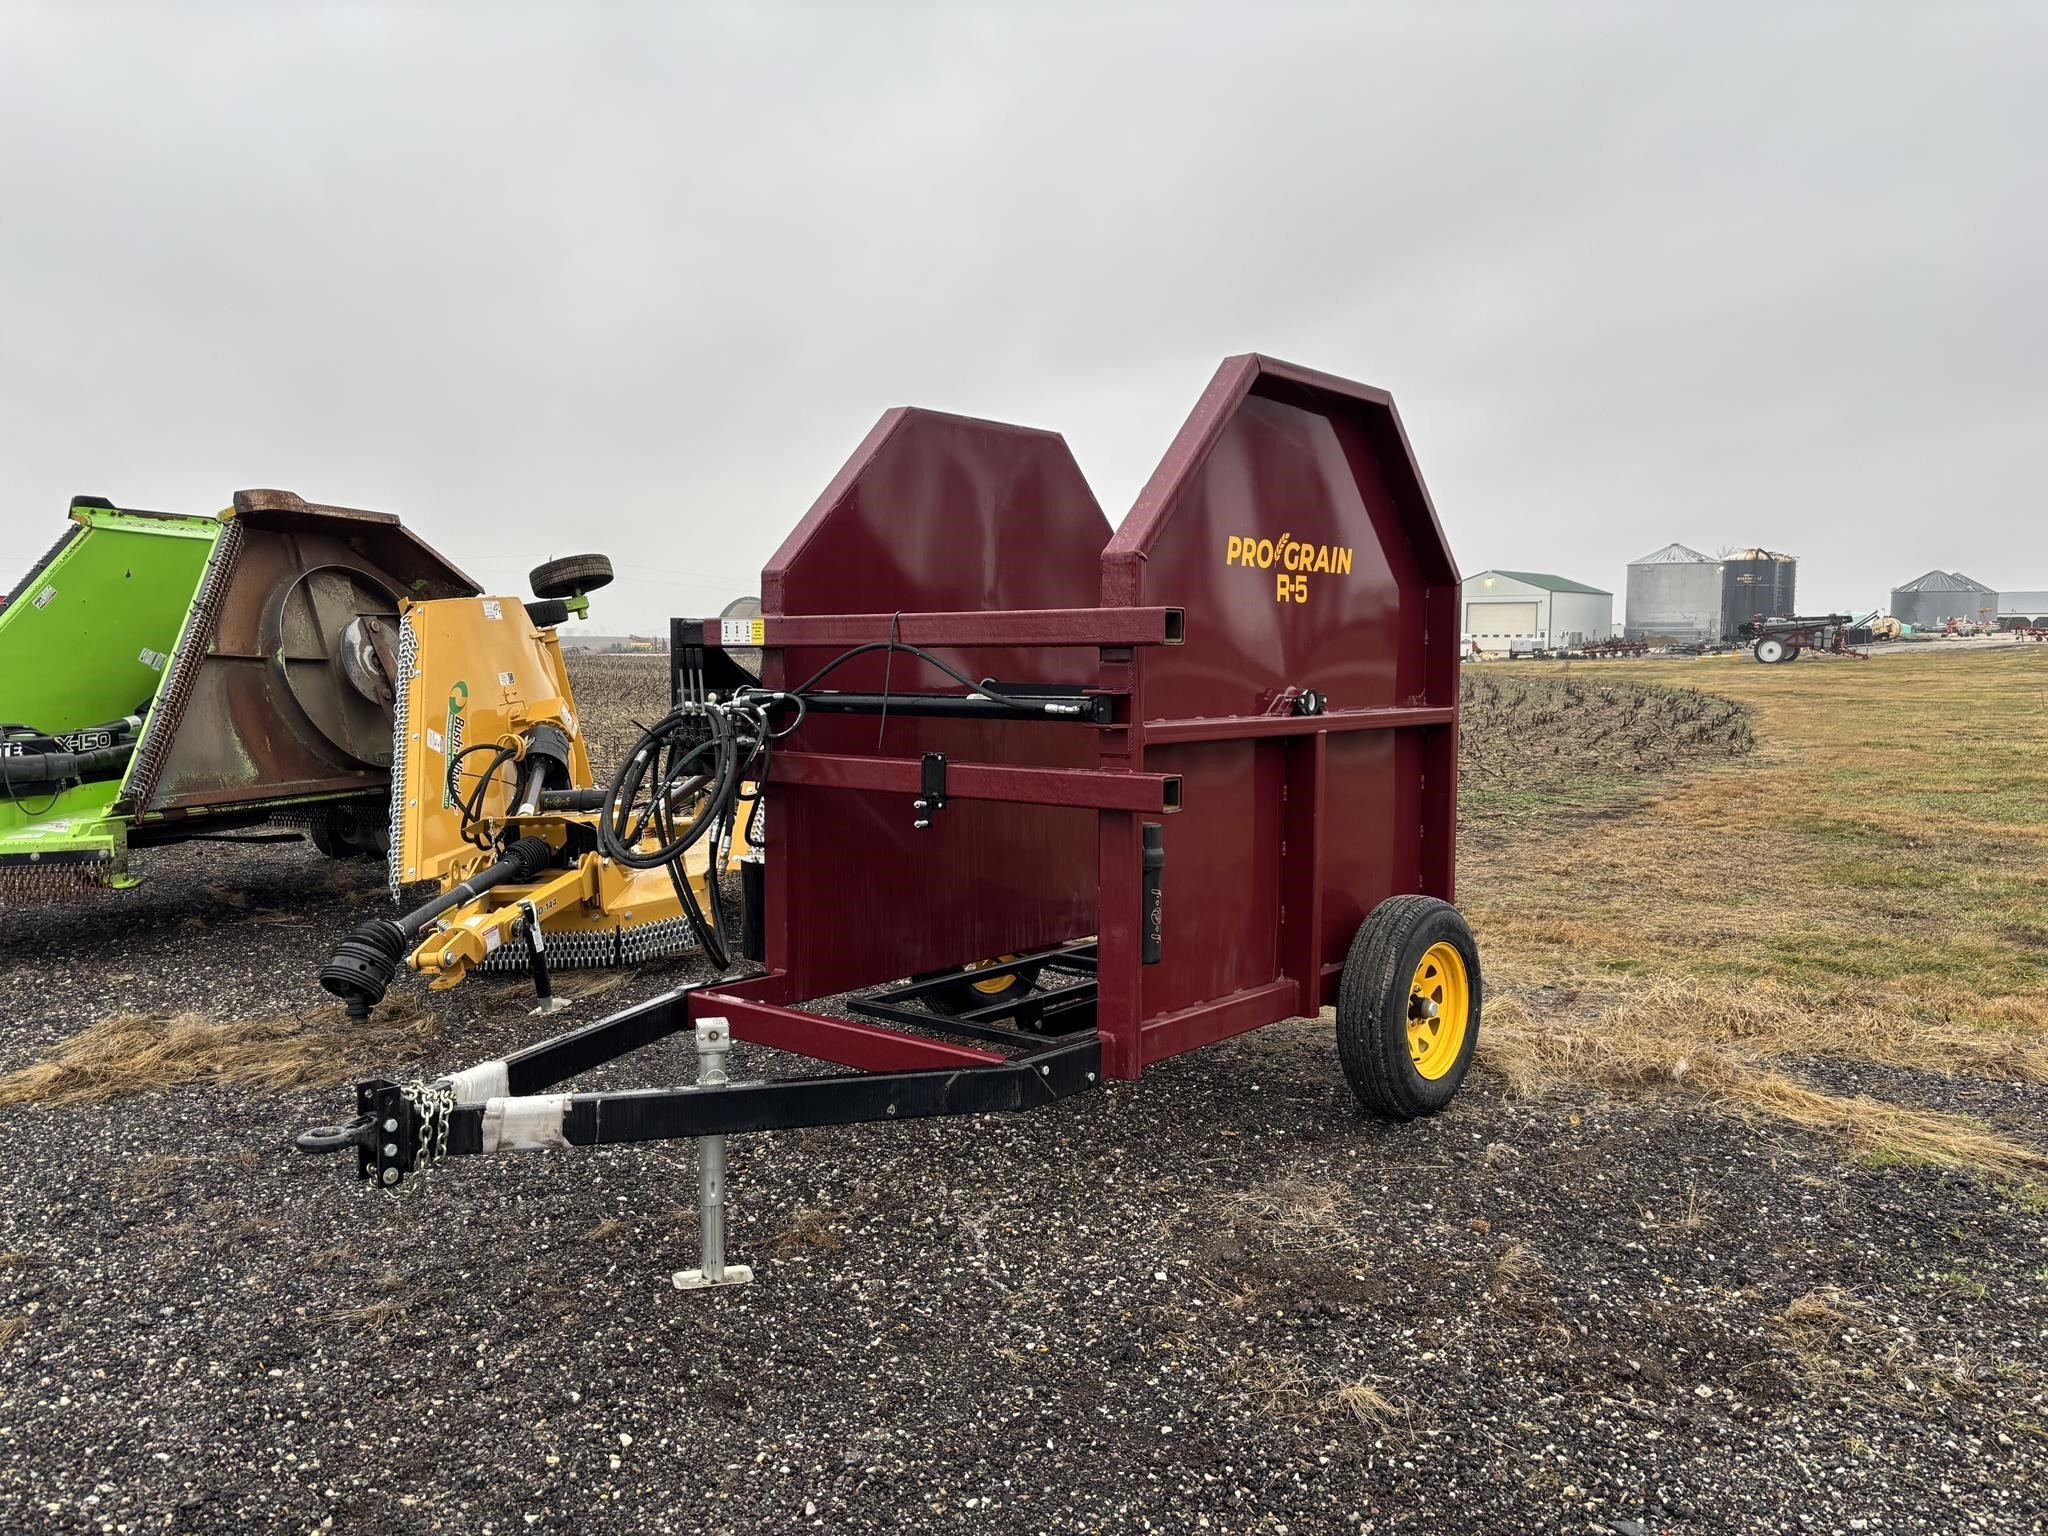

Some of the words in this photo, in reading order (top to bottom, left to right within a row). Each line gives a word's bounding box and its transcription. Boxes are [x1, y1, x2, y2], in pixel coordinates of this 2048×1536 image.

[1226, 535, 1274, 569] PRO
[1283, 541, 1353, 575] GRAIN
[1276, 573, 1308, 604] R-5
[54, 731, 112, 753] X-150
[450, 716, 465, 810] Bush-Whacr
